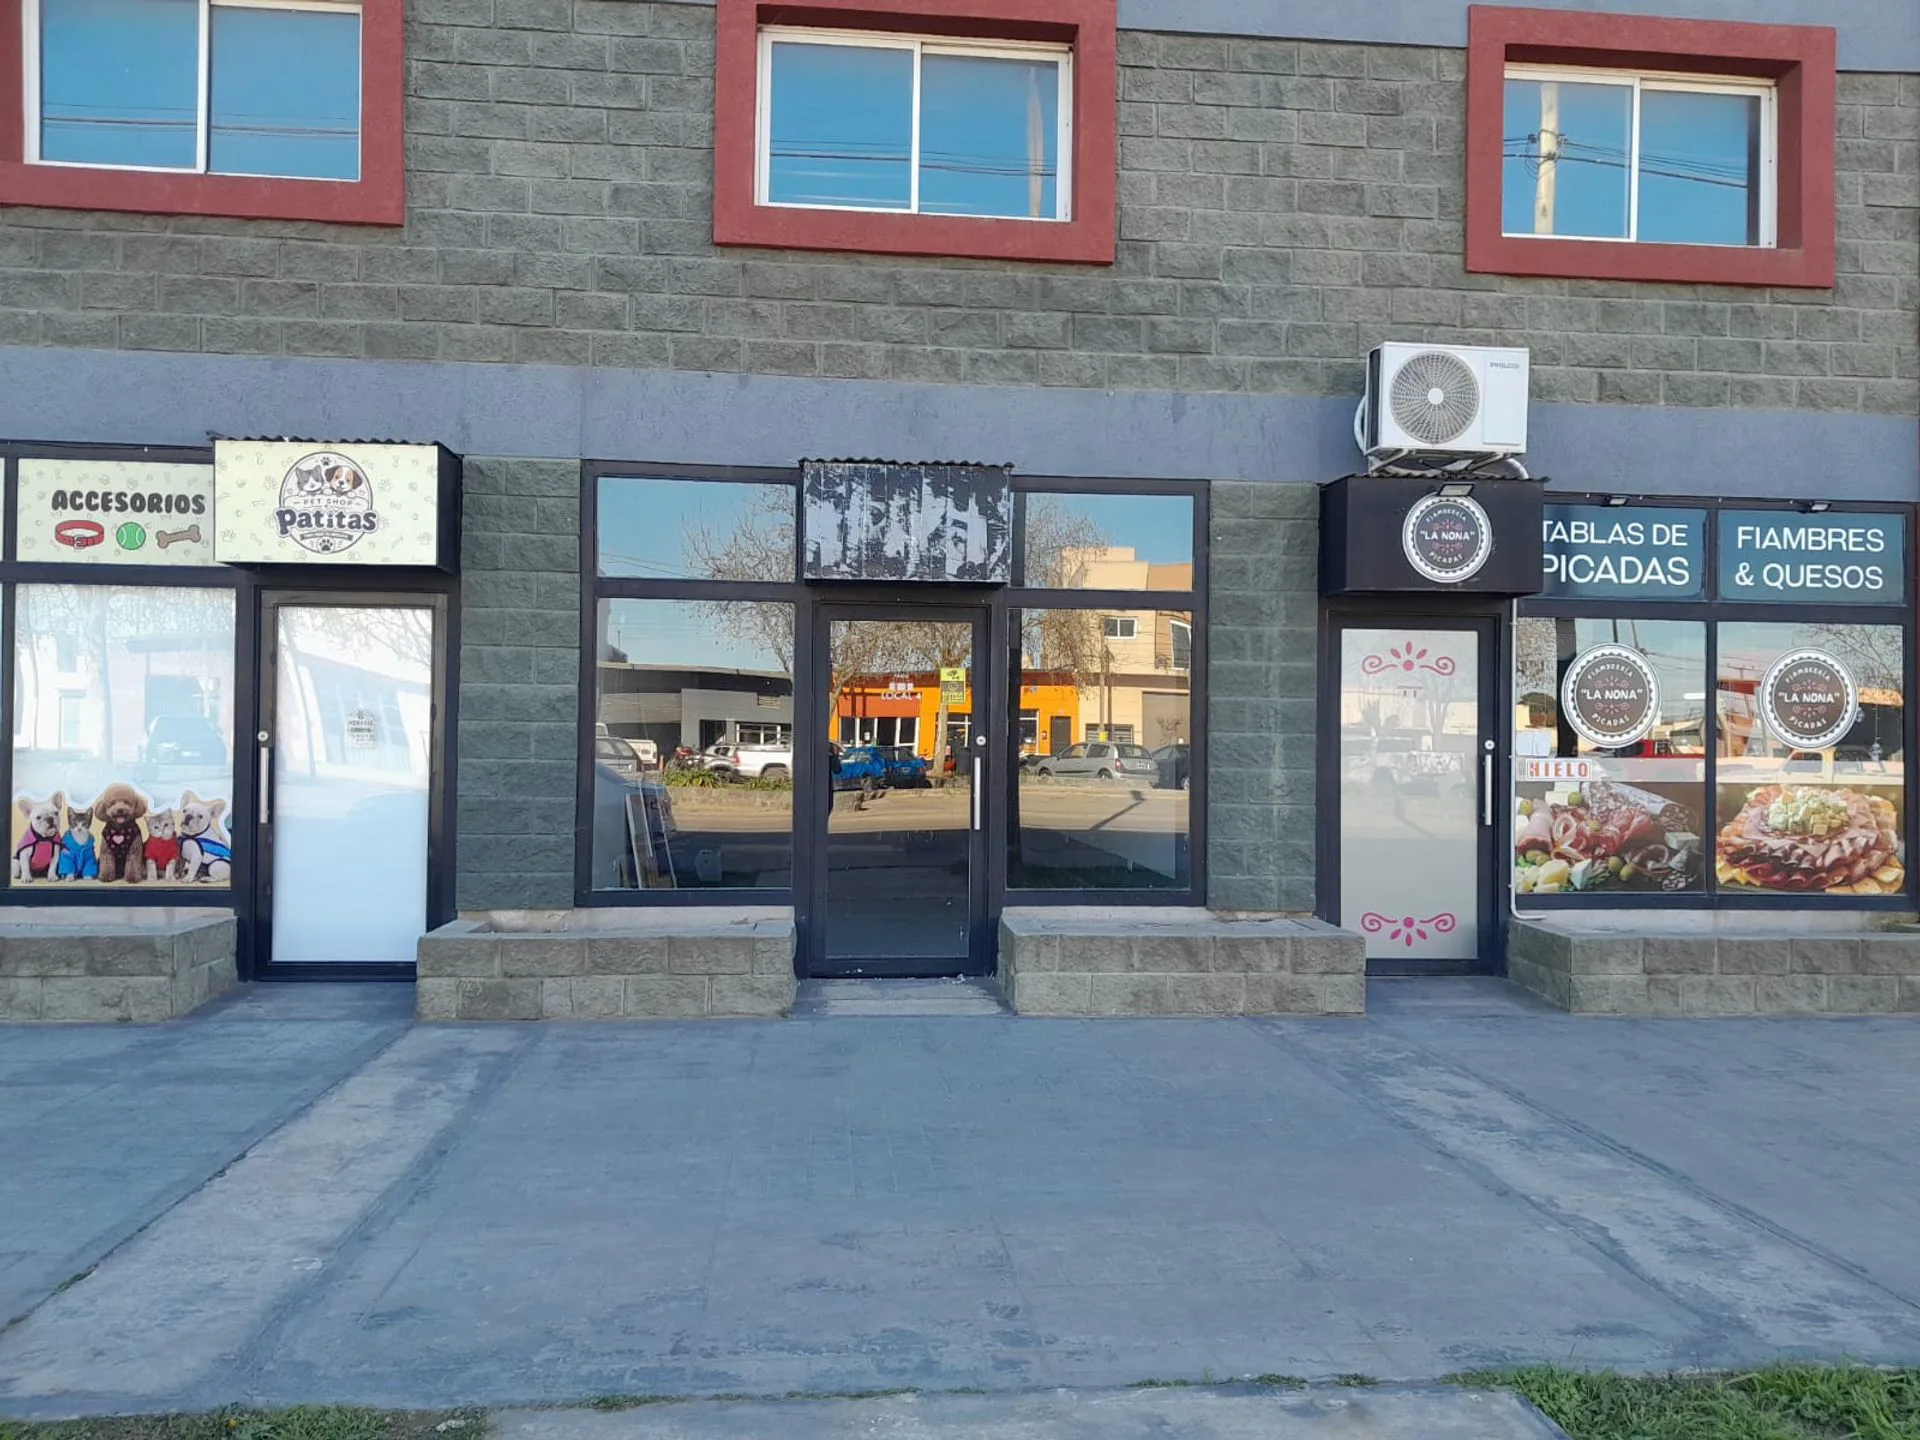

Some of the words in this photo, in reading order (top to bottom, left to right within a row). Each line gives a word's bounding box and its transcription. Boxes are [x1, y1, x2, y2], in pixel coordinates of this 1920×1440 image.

[52, 490, 205, 514] ACCESORIOS
[326, 498, 353, 506] SHOP
[276, 509, 377, 535] Patitas
[1652, 523, 1688, 546] DE
[1737, 526, 1885, 552] FIAMBRES
[1429, 551, 1463, 564] PICADAS
[1735, 562, 1755, 586] &
[1762, 562, 1884, 590] QUESOS
[881, 691, 913, 701] LOCAL
[1591, 712, 1630, 727] PICADAS
[1788, 715, 1827, 729] PICADAS
[1529, 762, 1588, 777] HIELO
